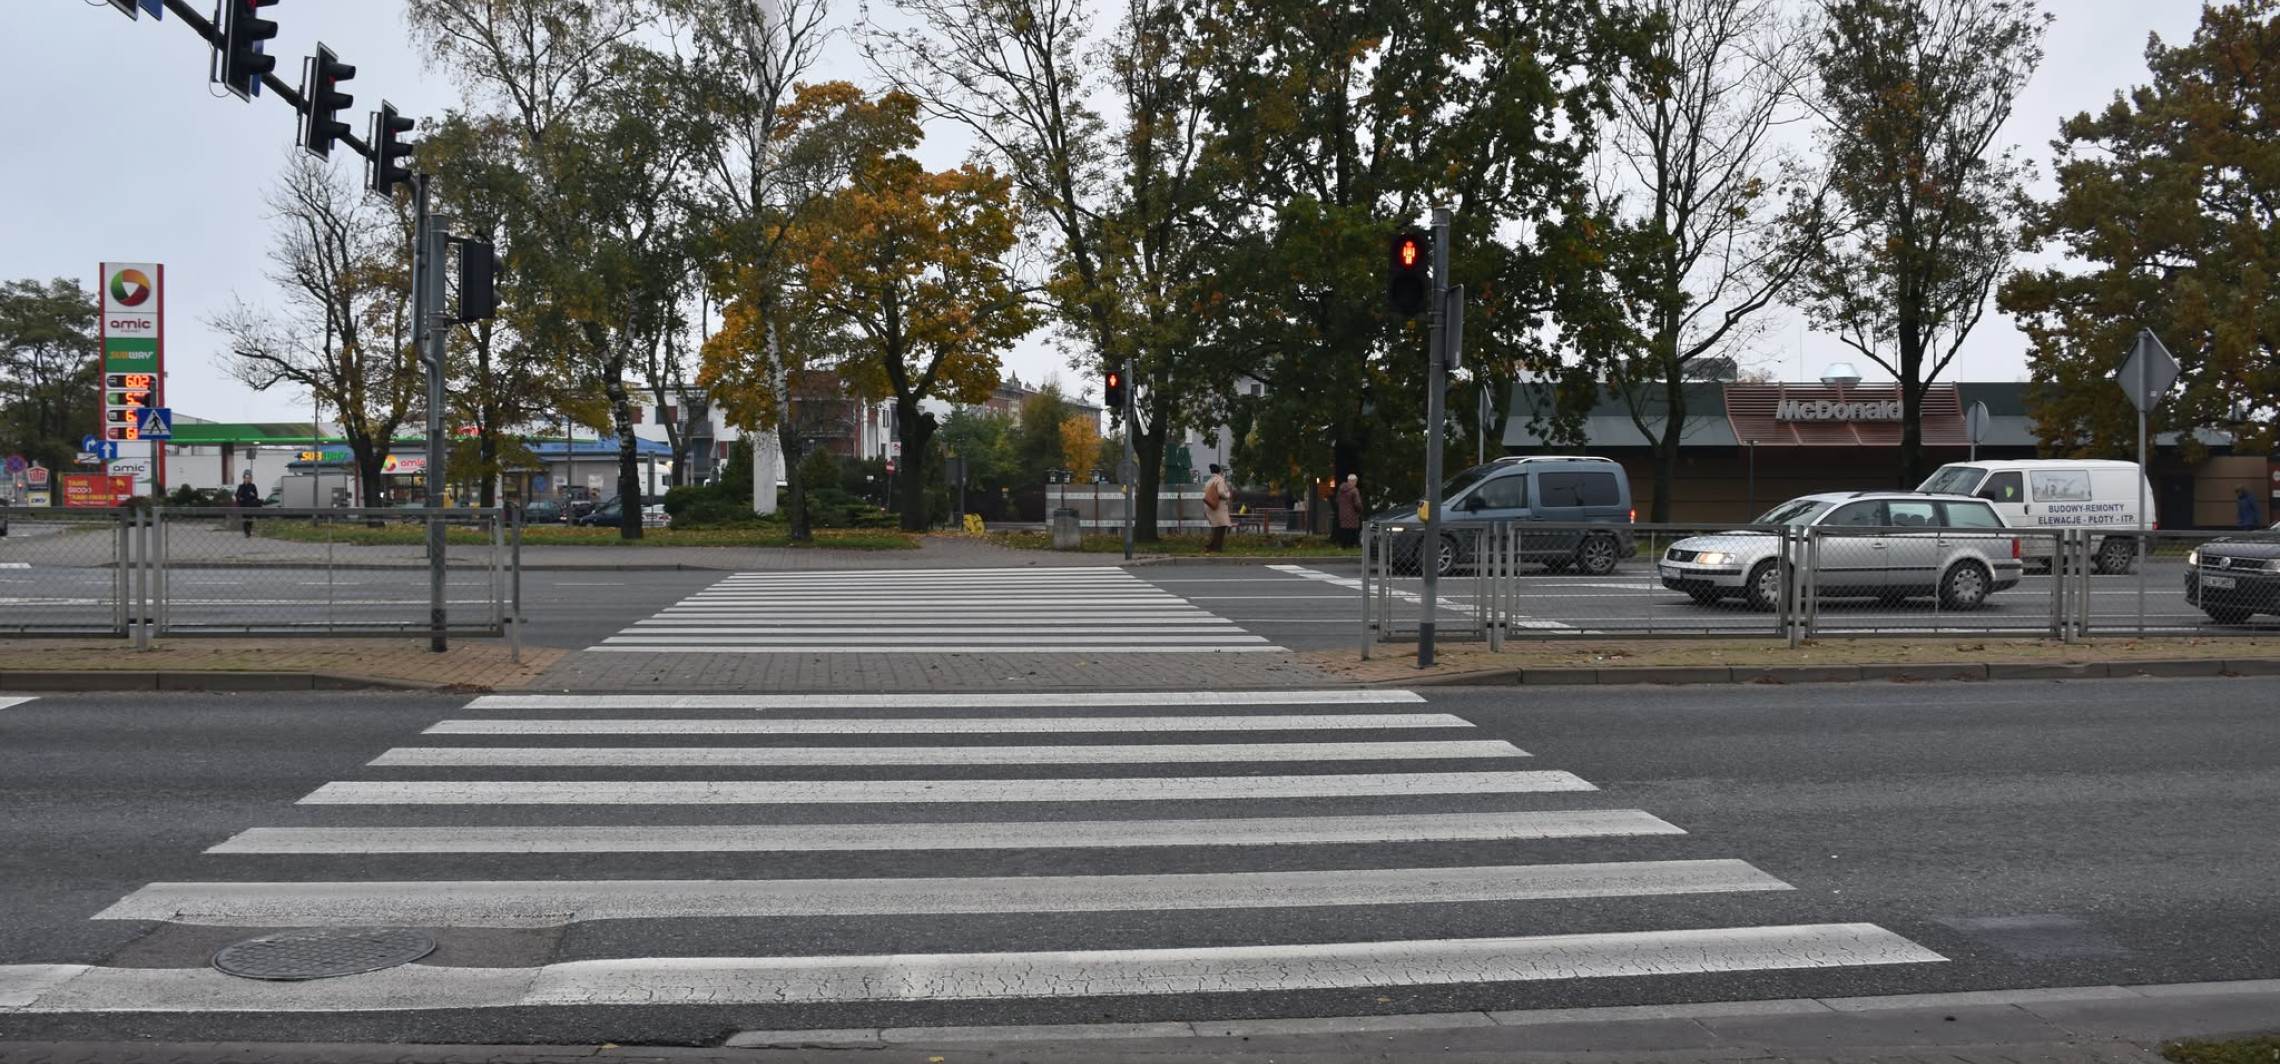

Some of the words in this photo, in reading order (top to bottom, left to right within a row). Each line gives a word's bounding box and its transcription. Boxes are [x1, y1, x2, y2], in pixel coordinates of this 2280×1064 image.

[110, 318, 151, 329] amic
[109, 351, 152, 360] SUBWAY
[125, 375, 150, 389] 602
[1775, 399, 1905, 421] McDonald
[112, 463, 145, 472] amic
[2048, 503, 2124, 513] BUDOWY-REMONTY
[2037, 516, 2082, 525] ELEWACJE
